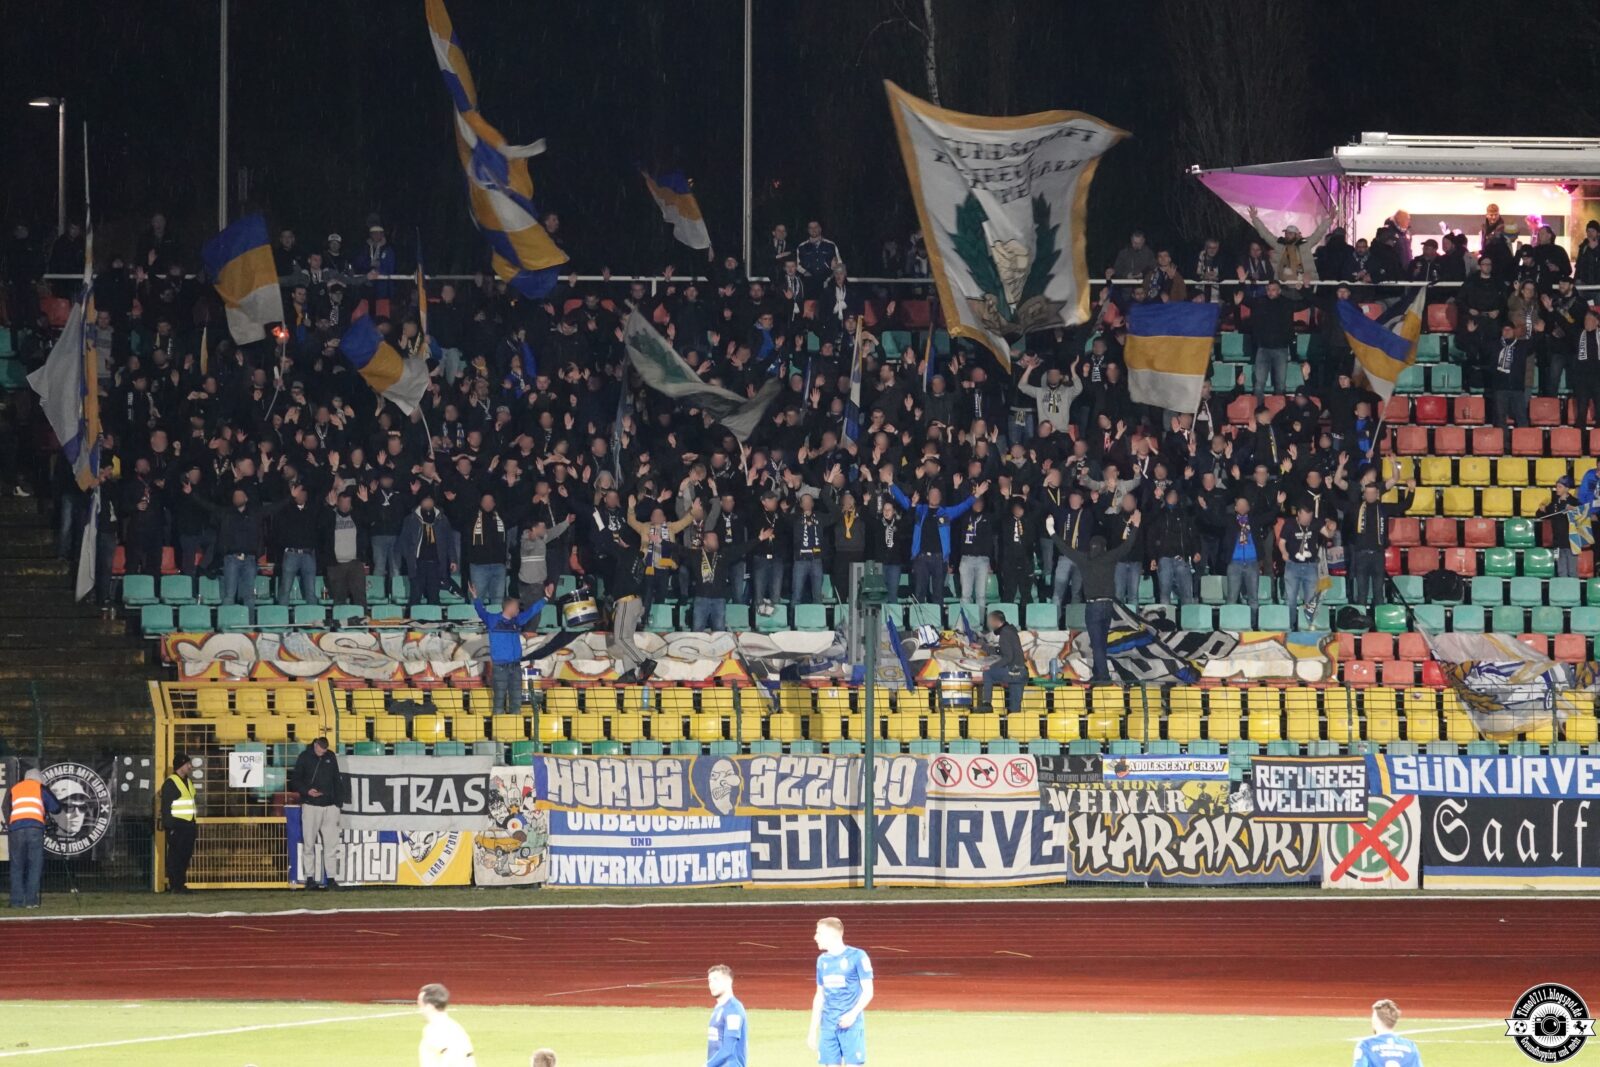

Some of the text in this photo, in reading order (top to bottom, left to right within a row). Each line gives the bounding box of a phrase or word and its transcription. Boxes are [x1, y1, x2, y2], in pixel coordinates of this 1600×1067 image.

[238, 755, 255, 763] TOR
[1128, 761, 1226, 772] ADOLESCENT CREW
[76, 767, 94, 780] MIT
[91, 779, 107, 798] UNS
[1255, 765, 1365, 789] REFUGEES
[1392, 755, 1600, 795] SÜDKURVE
[341, 777, 486, 813] ULTRAS
[1046, 788, 1188, 813] WEIMAR
[1256, 789, 1365, 813] WELCOME
[69, 838, 91, 852] IRON
[88, 817, 108, 842] MIND
[630, 837, 653, 847] UND
[750, 809, 1066, 870] SÜDKURVE
[1071, 813, 1314, 871] HARAKIRI
[548, 850, 748, 884] UNVERKÄUFLICH
